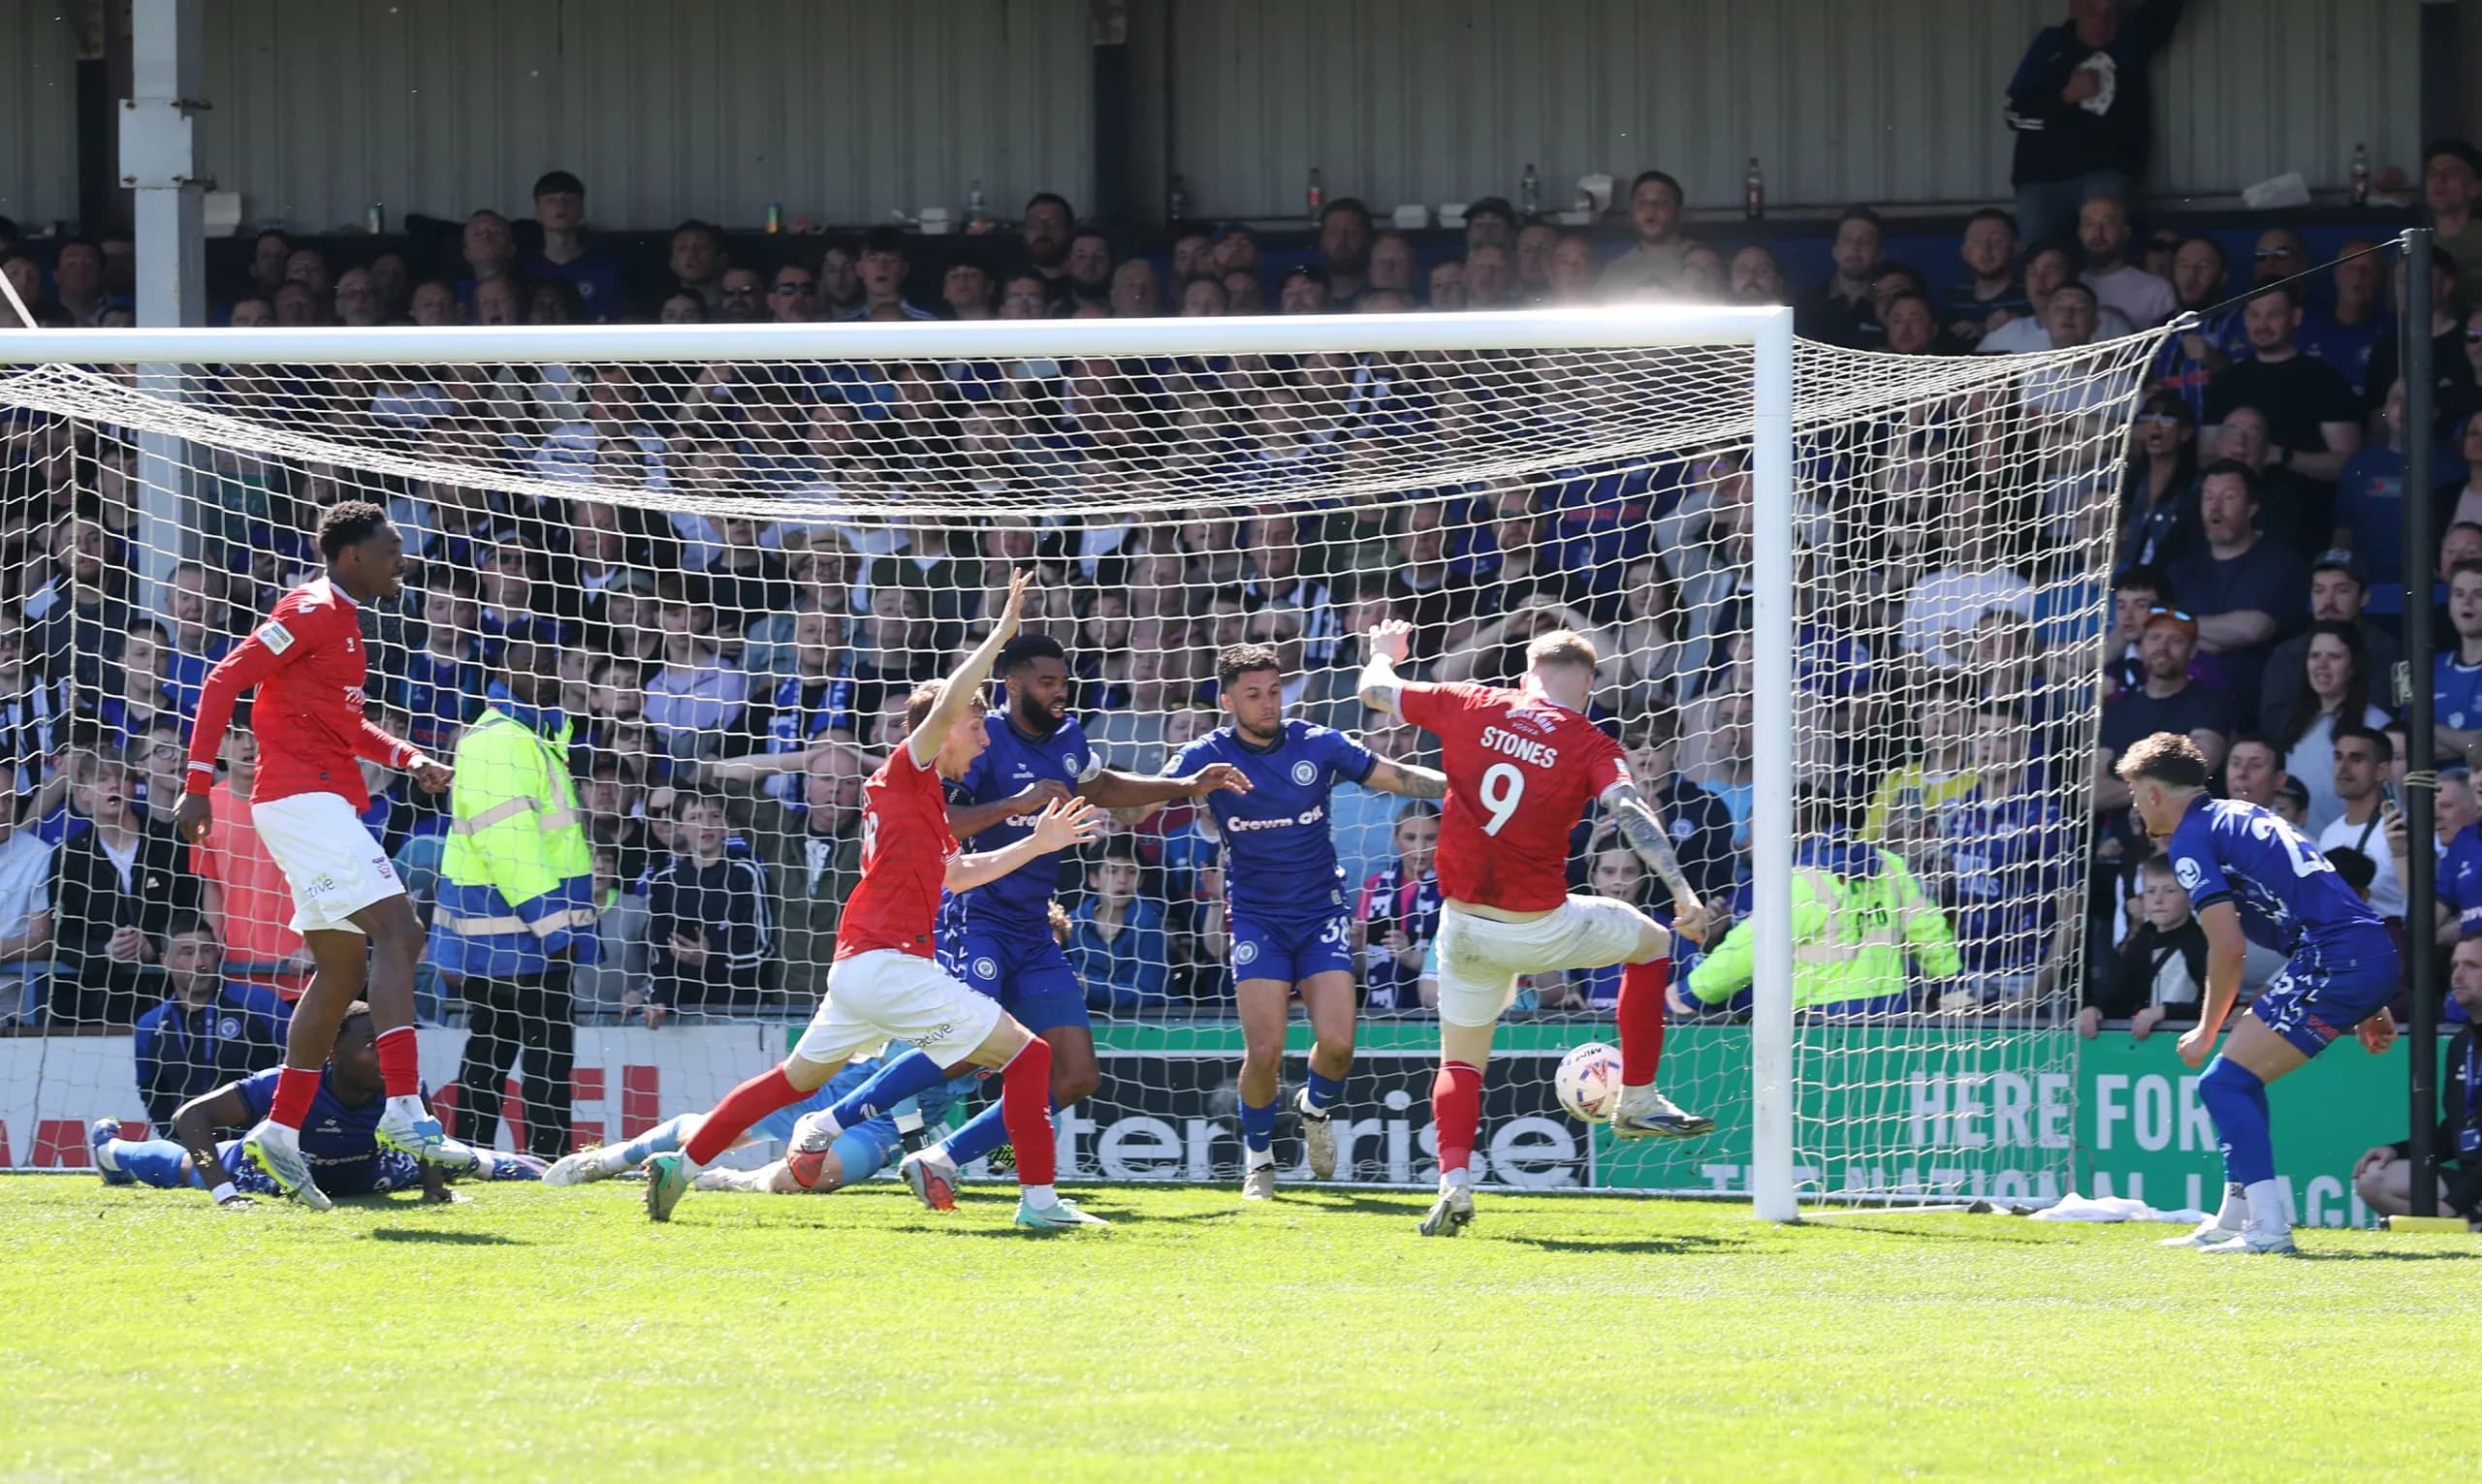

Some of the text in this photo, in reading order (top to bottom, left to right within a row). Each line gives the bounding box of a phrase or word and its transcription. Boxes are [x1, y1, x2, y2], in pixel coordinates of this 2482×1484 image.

[1480, 725, 1559, 769] STONES
[1480, 762, 1526, 837] 9
[1005, 814, 1037, 827] Cro
[1227, 816, 1293, 833] Crown
[1321, 916, 1351, 947] 38
[1910, 1071, 2218, 1152] HERE FOR
